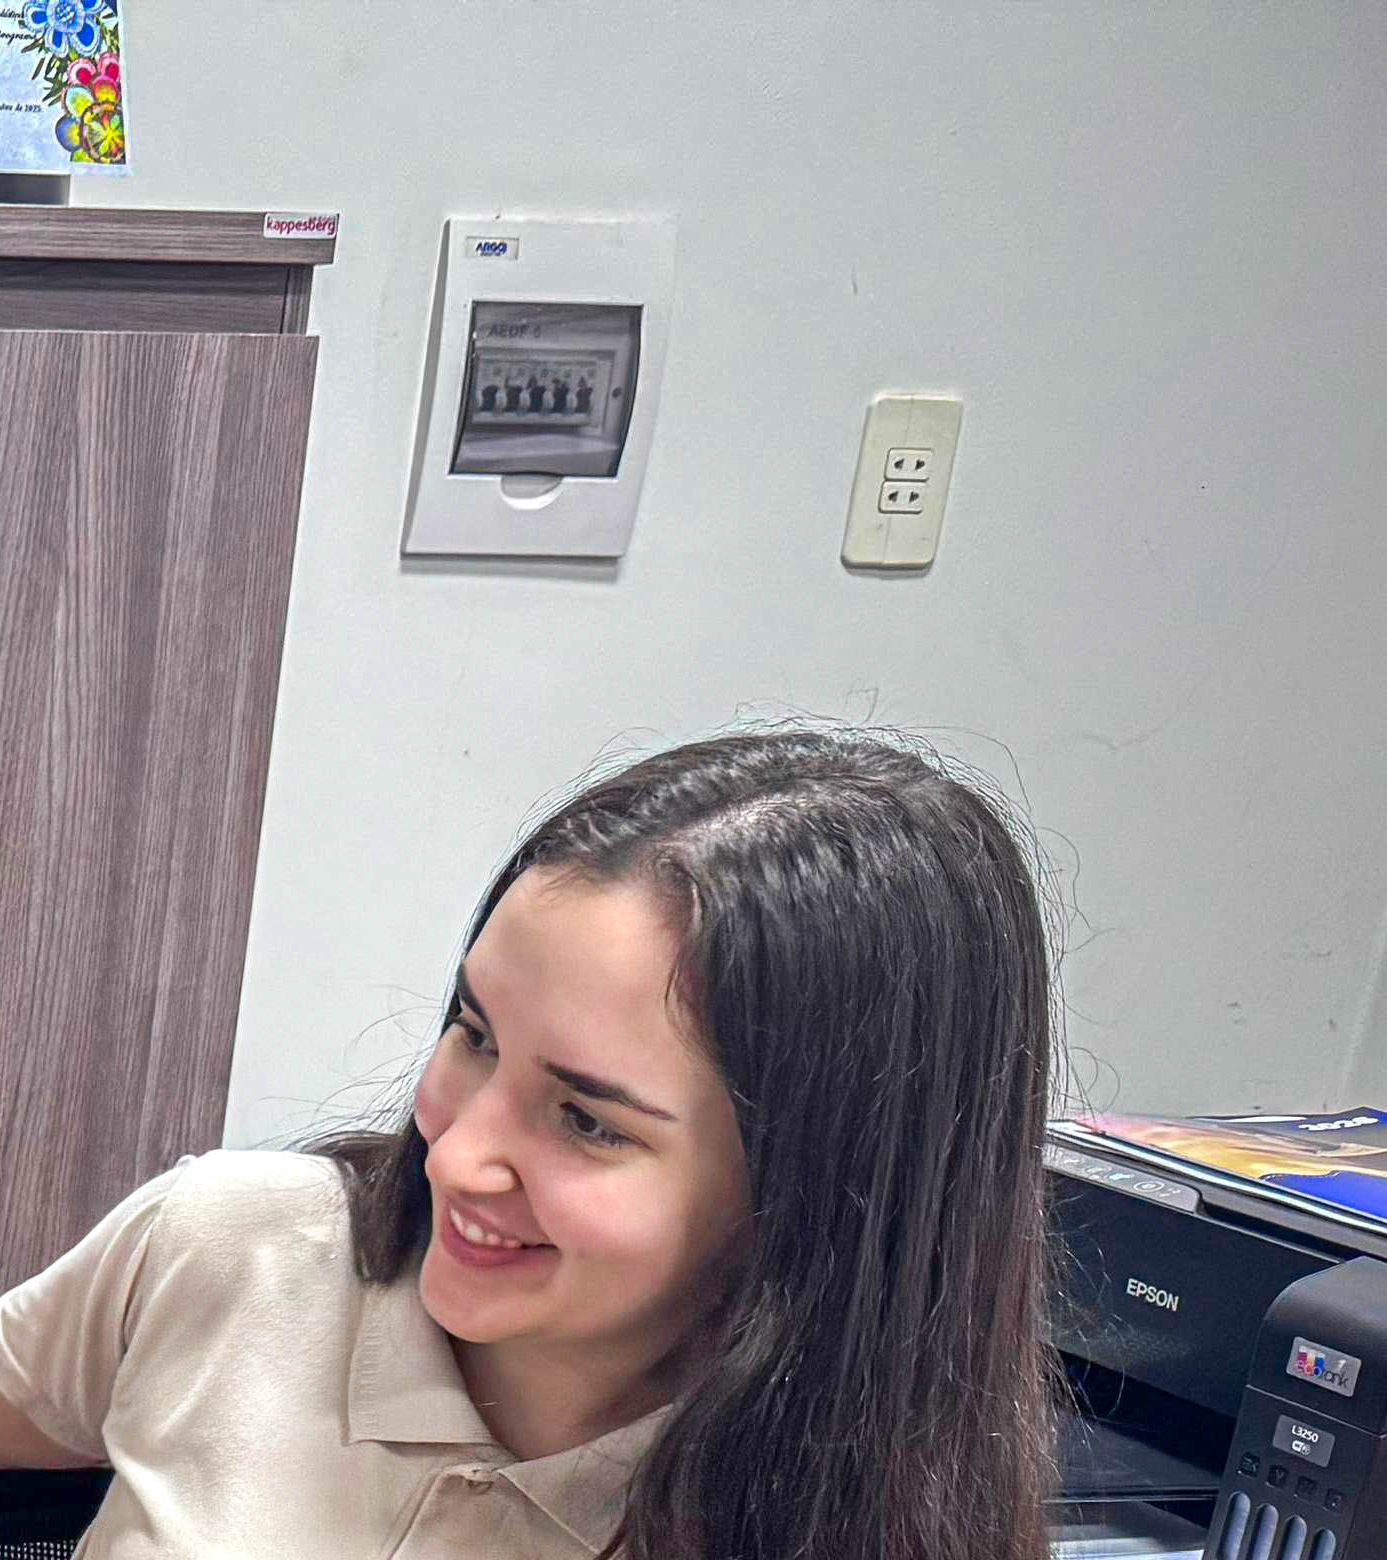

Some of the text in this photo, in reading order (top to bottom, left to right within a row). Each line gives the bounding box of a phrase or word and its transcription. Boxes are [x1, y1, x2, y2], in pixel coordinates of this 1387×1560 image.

[266, 214, 337, 236] kappesberg
[1126, 1277, 1180, 1313] EPSON
[1292, 1424, 1319, 1443] L3250
